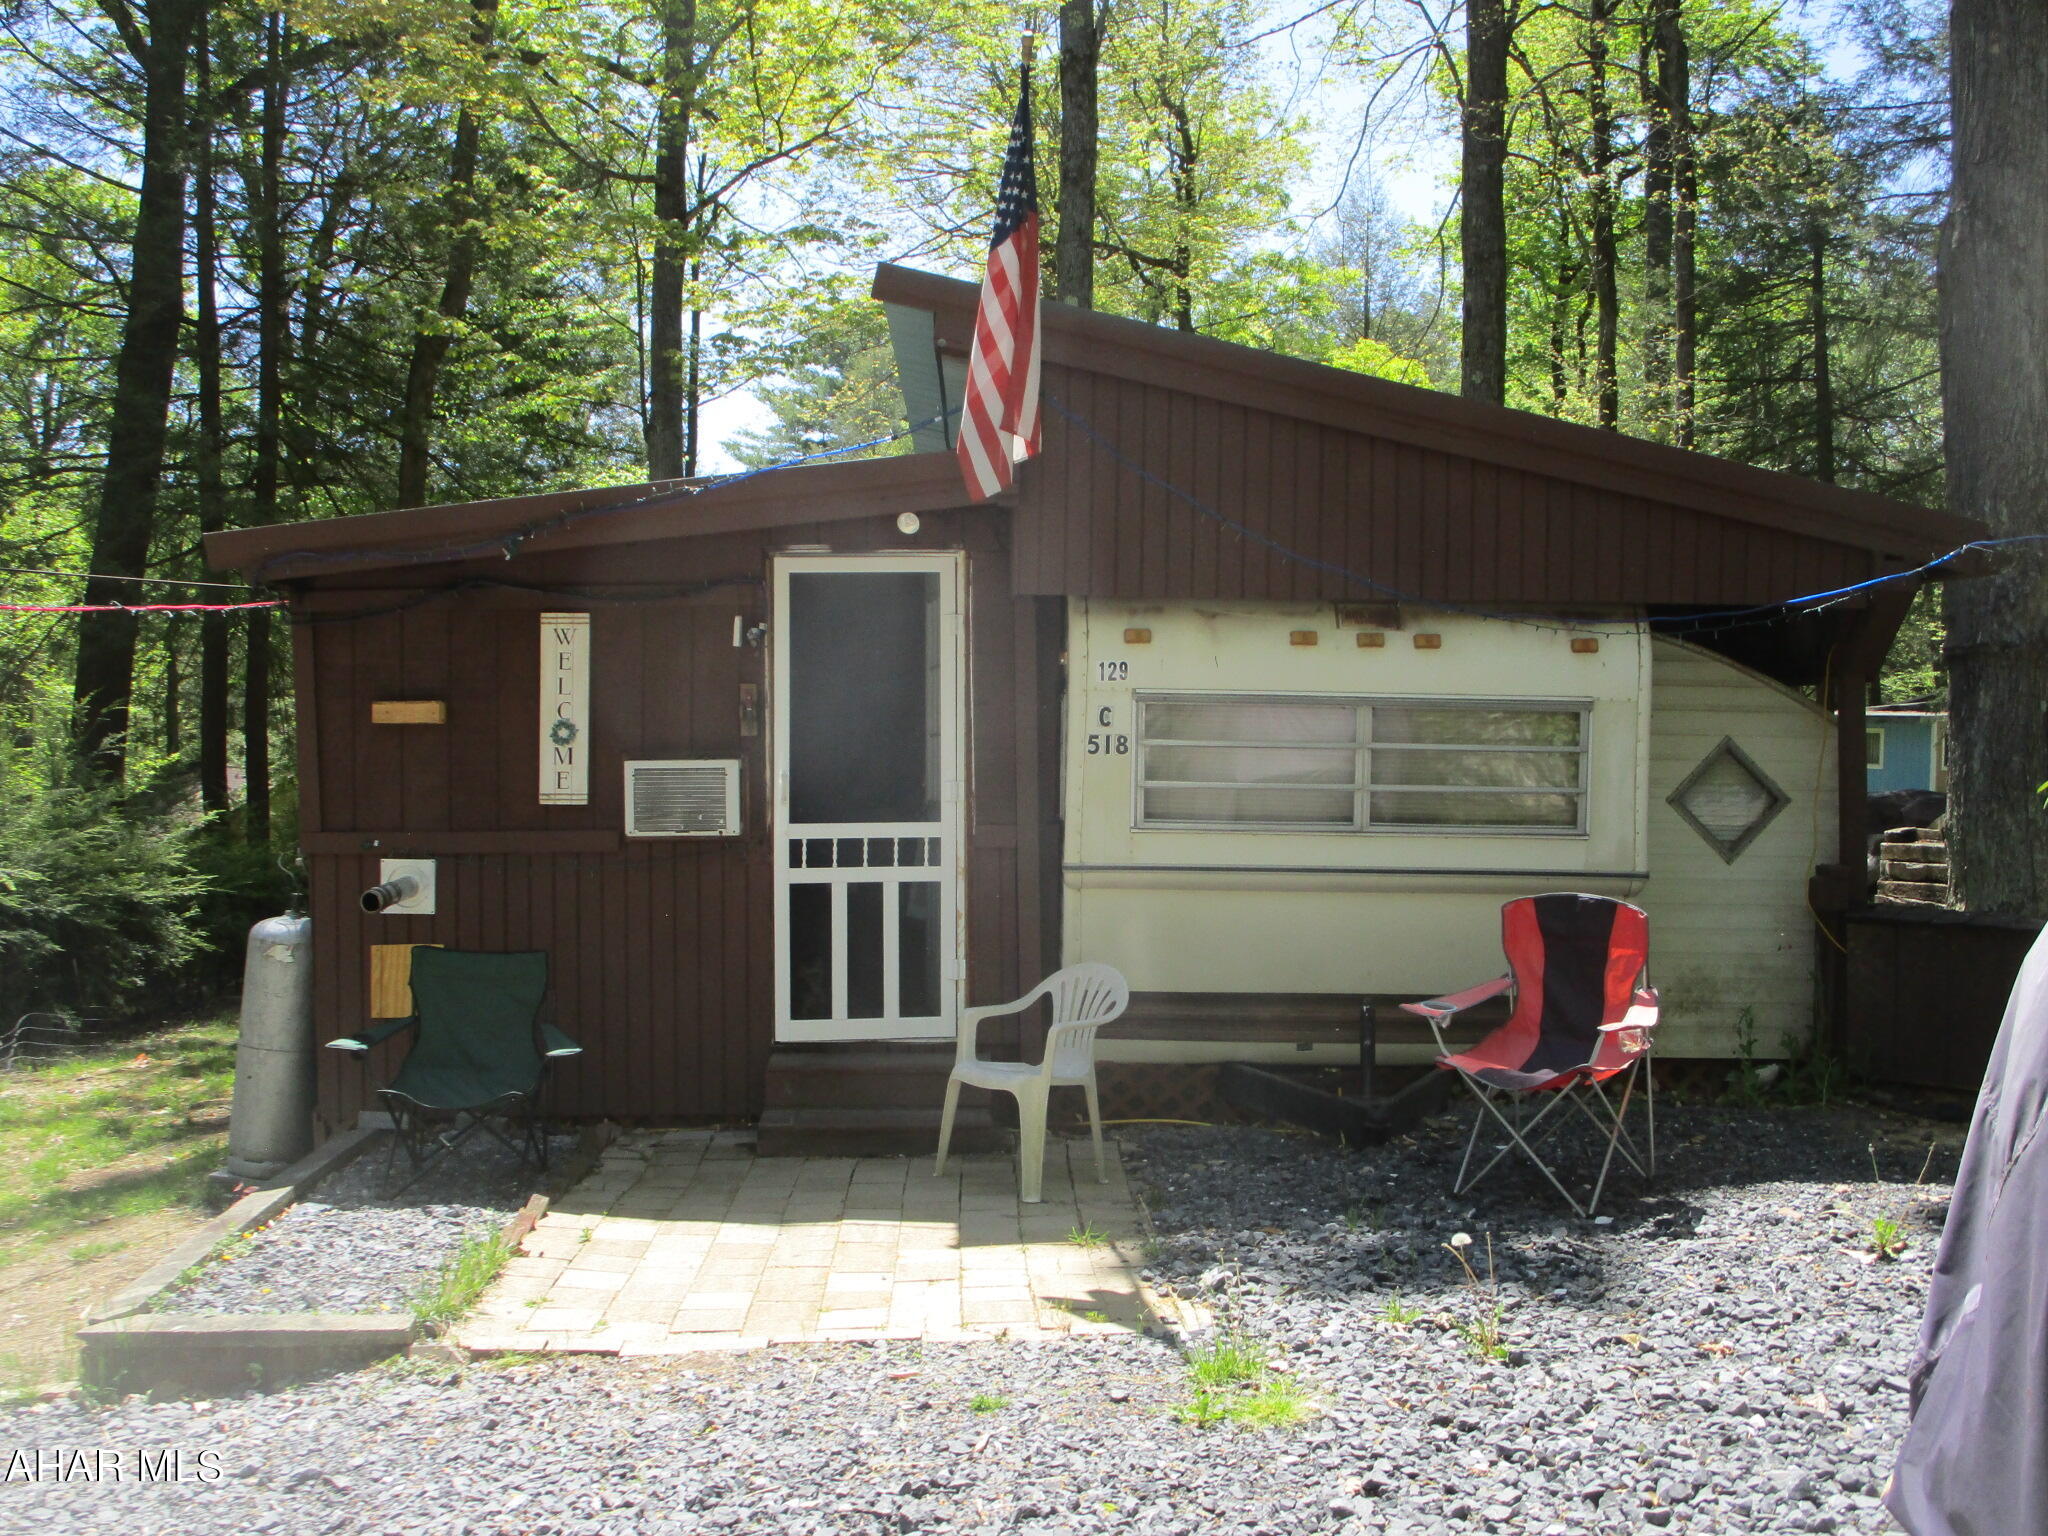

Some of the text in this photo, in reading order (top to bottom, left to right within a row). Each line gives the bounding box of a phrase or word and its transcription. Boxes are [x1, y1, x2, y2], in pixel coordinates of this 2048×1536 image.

[1099, 661, 1128, 681] 129
[1099, 706, 1112, 727] C
[1087, 734, 1129, 755] 518
